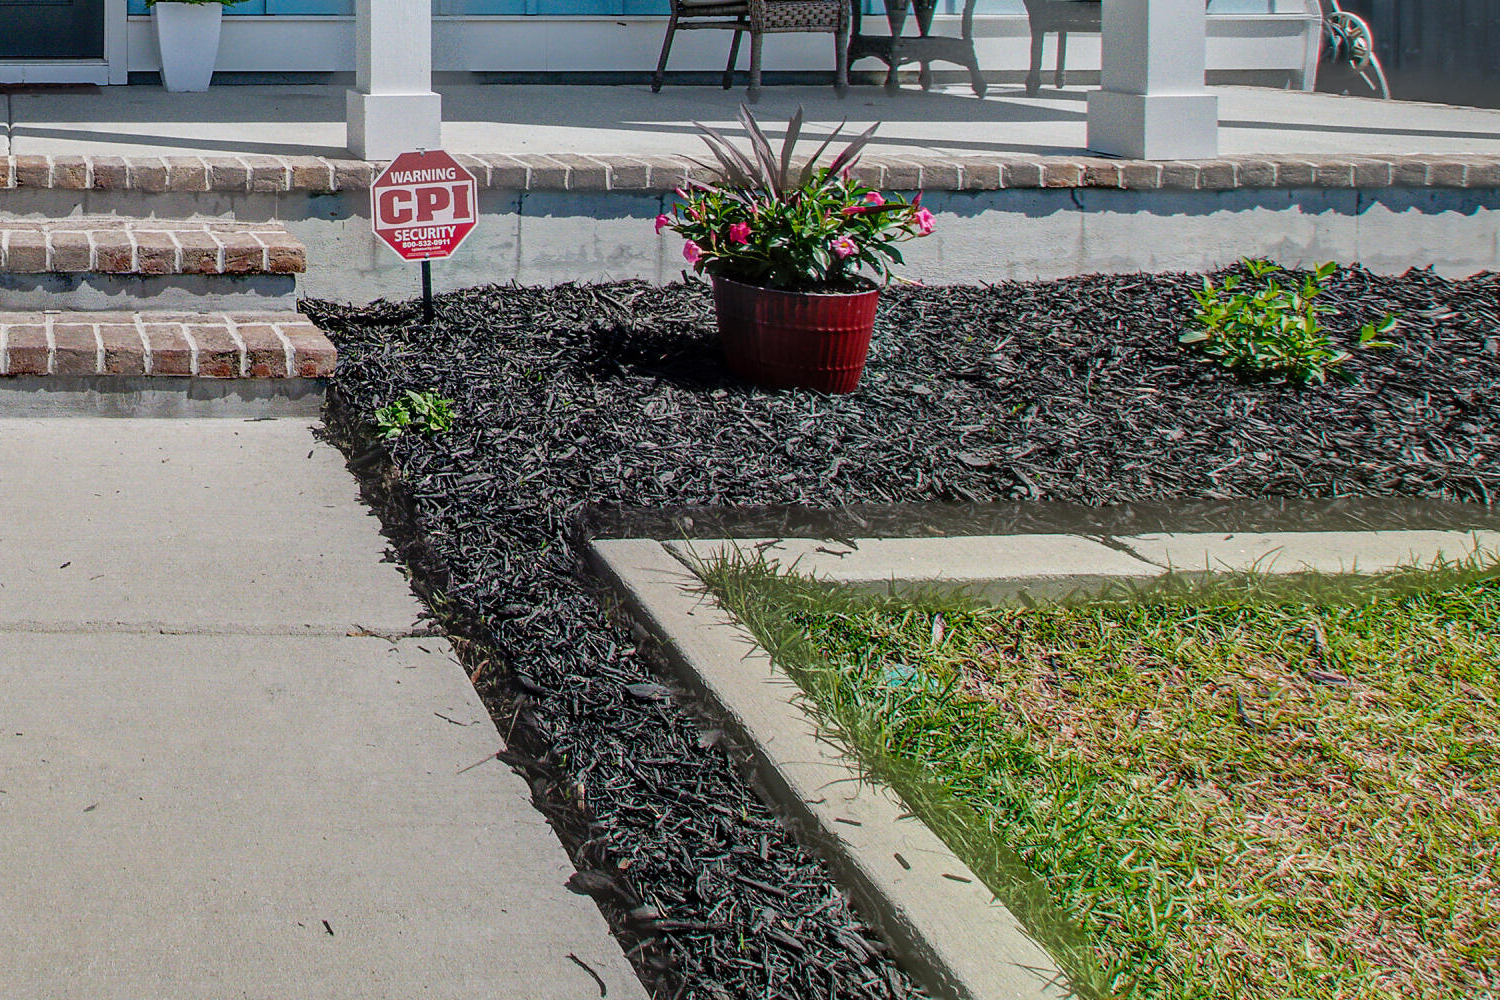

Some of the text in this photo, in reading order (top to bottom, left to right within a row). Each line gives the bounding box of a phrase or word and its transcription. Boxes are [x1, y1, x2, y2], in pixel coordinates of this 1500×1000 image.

[390, 167, 456, 184] WARNING
[379, 184, 471, 225] CPI
[394, 225, 457, 242] SECURITY
